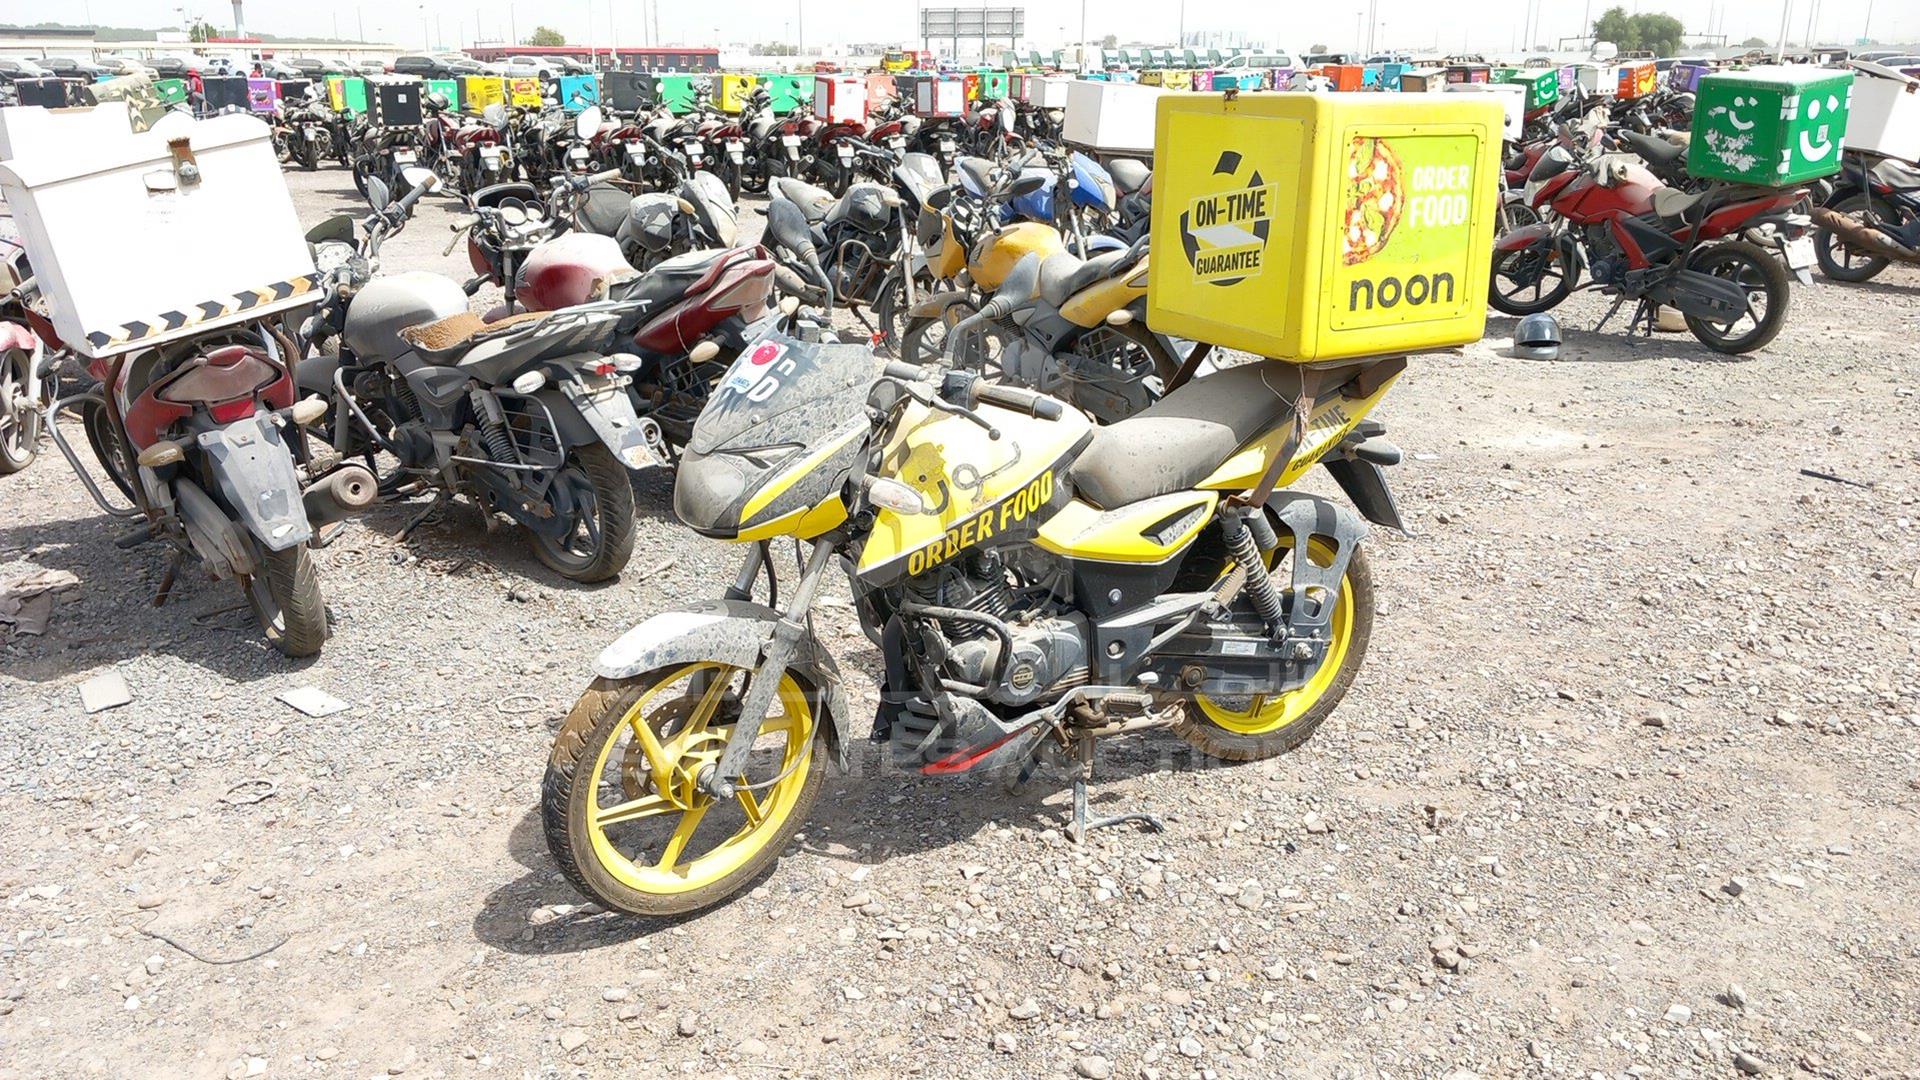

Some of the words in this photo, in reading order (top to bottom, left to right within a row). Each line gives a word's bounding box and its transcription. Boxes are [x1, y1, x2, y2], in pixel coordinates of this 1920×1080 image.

[1413, 164, 1470, 192] ORDER
[1196, 189, 1267, 227] ON-TIME
[1409, 194, 1468, 228] FOOD
[1196, 250, 1260, 275] GUARANTEE
[1349, 272, 1454, 312] noon
[908, 510, 994, 576] ORDER
[1000, 470, 1054, 531] FOOD
